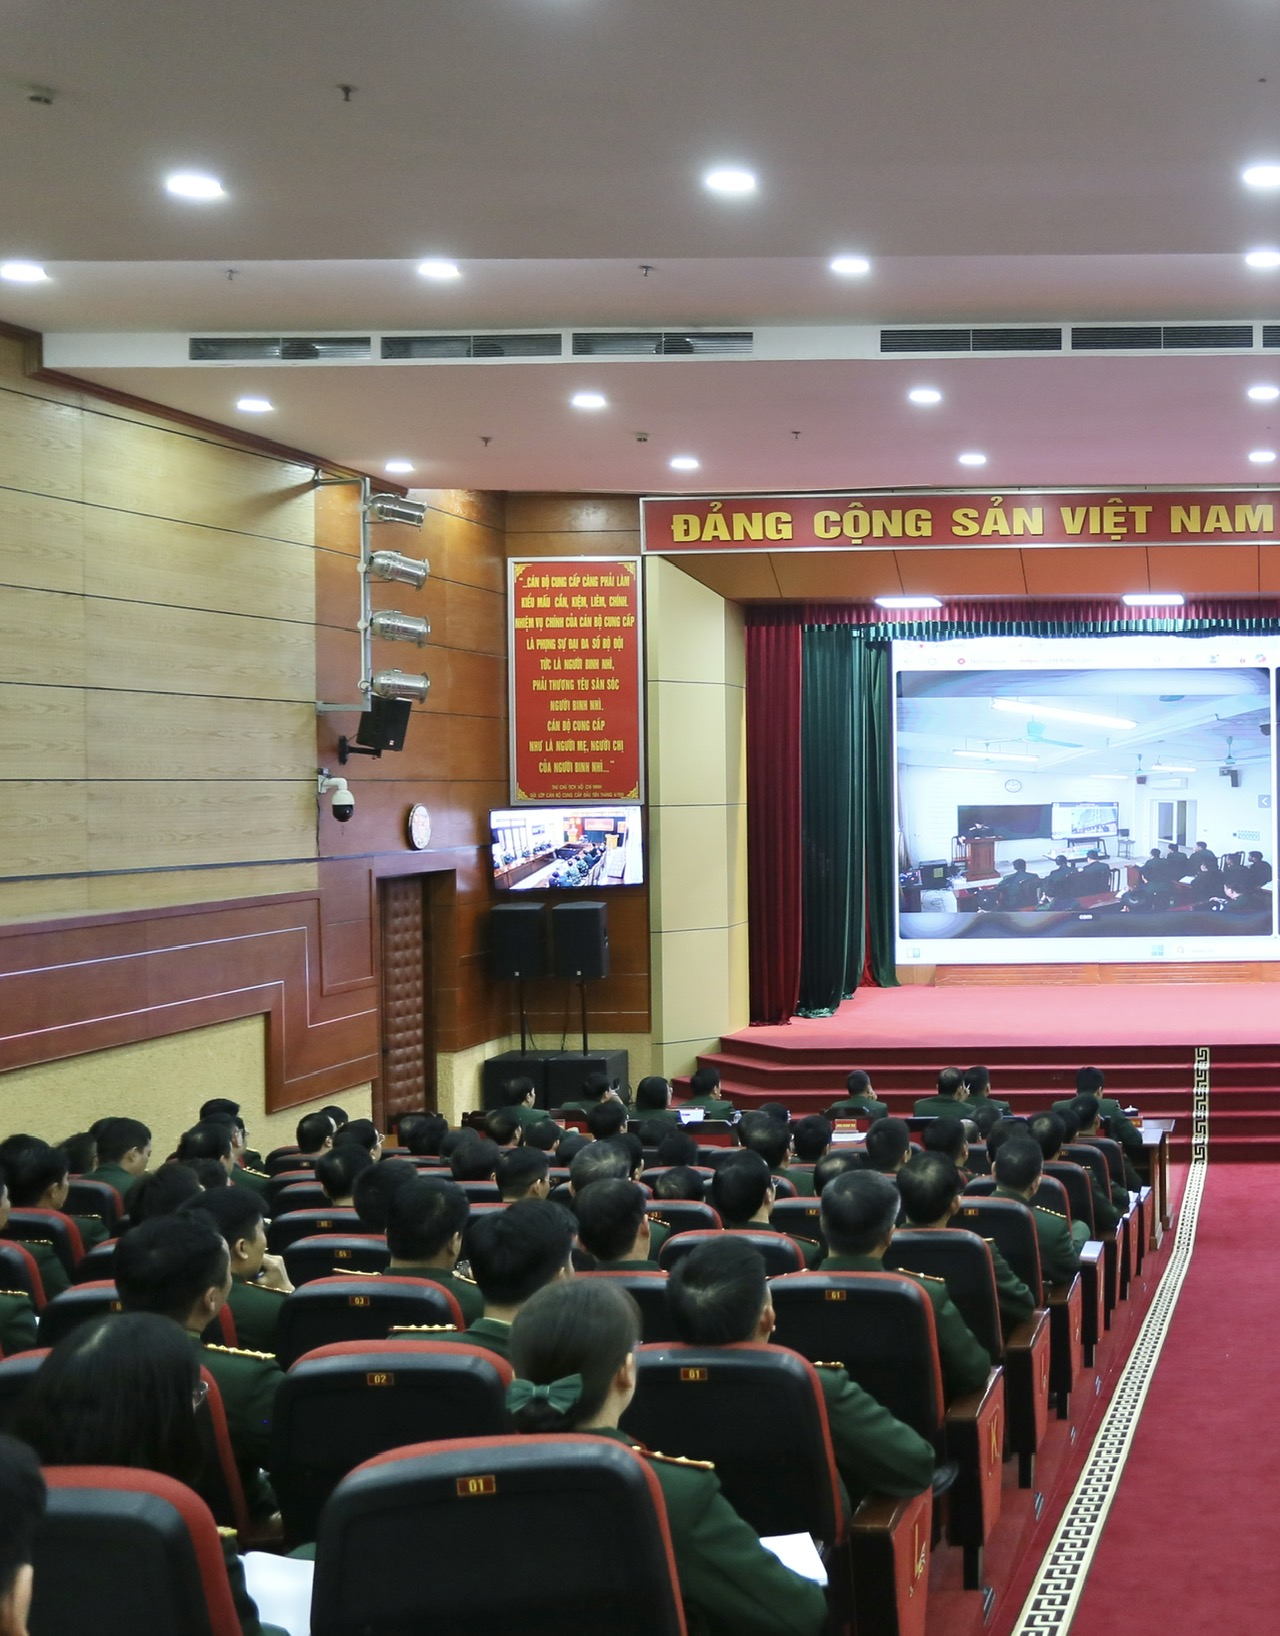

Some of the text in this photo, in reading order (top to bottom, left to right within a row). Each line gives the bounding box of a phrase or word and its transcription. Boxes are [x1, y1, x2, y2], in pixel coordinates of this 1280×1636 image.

[671, 502, 793, 542] ĐẢNG
[813, 502, 932, 544] CỘNG
[951, 496, 1044, 538] SẢN
[1060, 498, 1153, 540] VIỆT
[1170, 504, 1274, 533] NAM
[831, 1291, 841, 1299] 01
[354, 1297, 365, 1305] 03
[374, 1374, 388, 1384] 02
[689, 1369, 700, 1379] 01
[468, 1479, 484, 1492] 01
